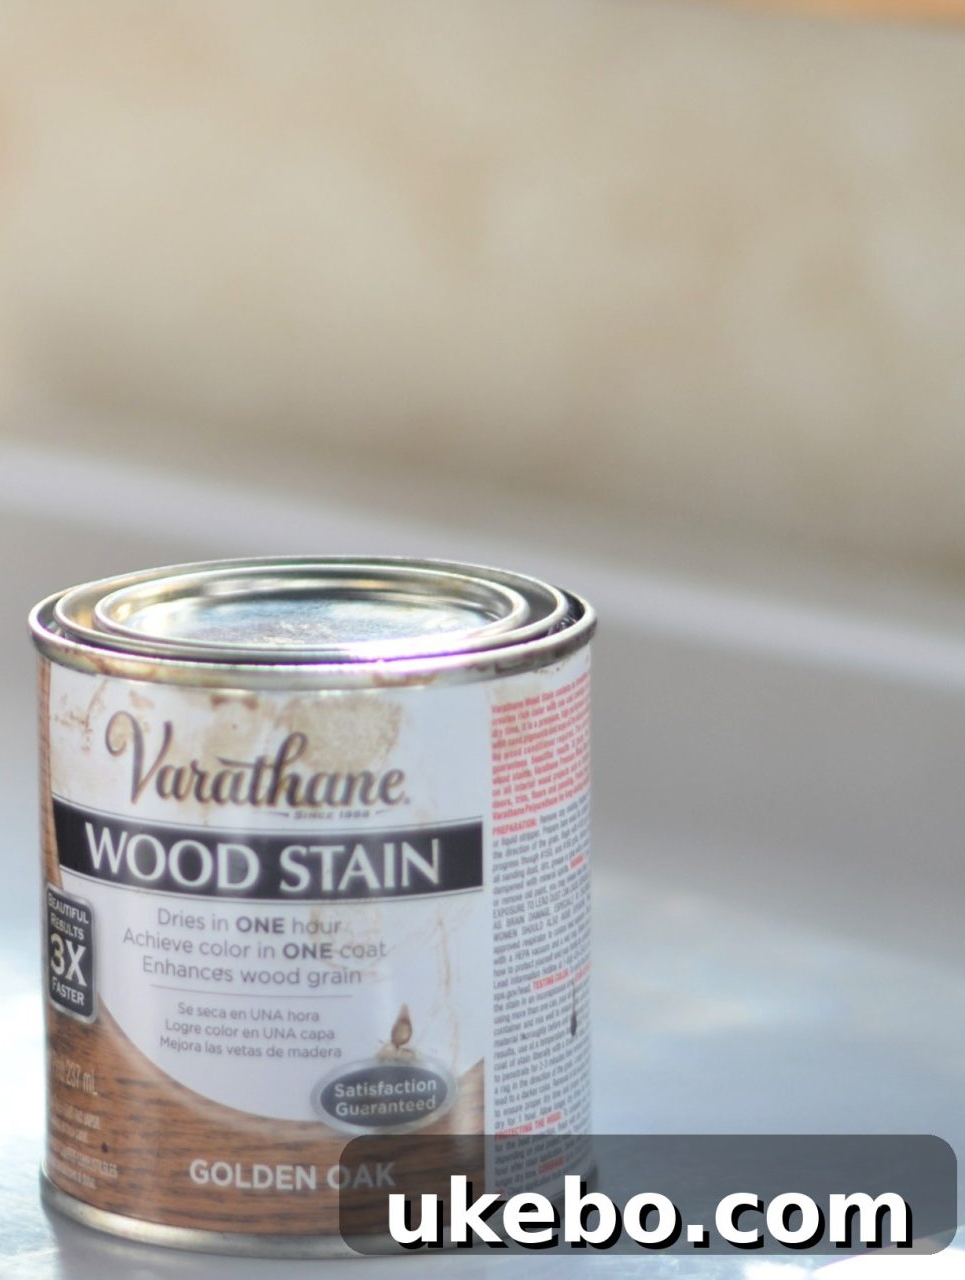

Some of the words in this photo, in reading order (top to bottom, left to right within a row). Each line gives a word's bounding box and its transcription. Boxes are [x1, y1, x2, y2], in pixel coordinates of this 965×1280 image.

[105, 709, 411, 809] Varathane
[85, 821, 261, 891] WOOD
[279, 838, 441, 892] STAIN
[47, 892, 89, 924] BEAUTIFUL
[157, 907, 206, 931] Dries
[211, 913, 229, 932] in
[235, 915, 285, 935] ONE
[291, 916, 342, 935] hour
[50, 912, 84, 940] RESULTS
[122, 927, 193, 954] Achieve
[198, 939, 251, 959] color
[257, 941, 275, 959] in
[282, 942, 333, 960] ONE
[338, 939, 387, 959] coat
[50, 932, 88, 987] 3X
[142, 955, 233, 983] Enhances
[239, 967, 300, 985] wood
[306, 966, 362, 989] grain
[52, 975, 85, 1006] FASTER
[177, 1001, 194, 1016] Se
[196, 1006, 227, 1019] seca
[229, 1009, 247, 1021] en
[250, 1008, 284, 1022] UNA
[287, 1008, 320, 1023] hora
[164, 1018, 201, 1035] Logre
[204, 1023, 239, 1038] color
[242, 1027, 259, 1039] en
[262, 1027, 297, 1040] UNA
[299, 1028, 335, 1042] capa
[159, 1035, 202, 1053] Mejora
[204, 1041, 223, 1055] las
[225, 1044, 263, 1057] vetas
[265, 1044, 284, 1058] de
[287, 1045, 342, 1059] madera
[334, 1078, 436, 1098] Satisfaction
[335, 1094, 436, 1116] Guaranteed
[189, 1157, 317, 1192] GOLDEN
[327, 1161, 397, 1191] OAK
